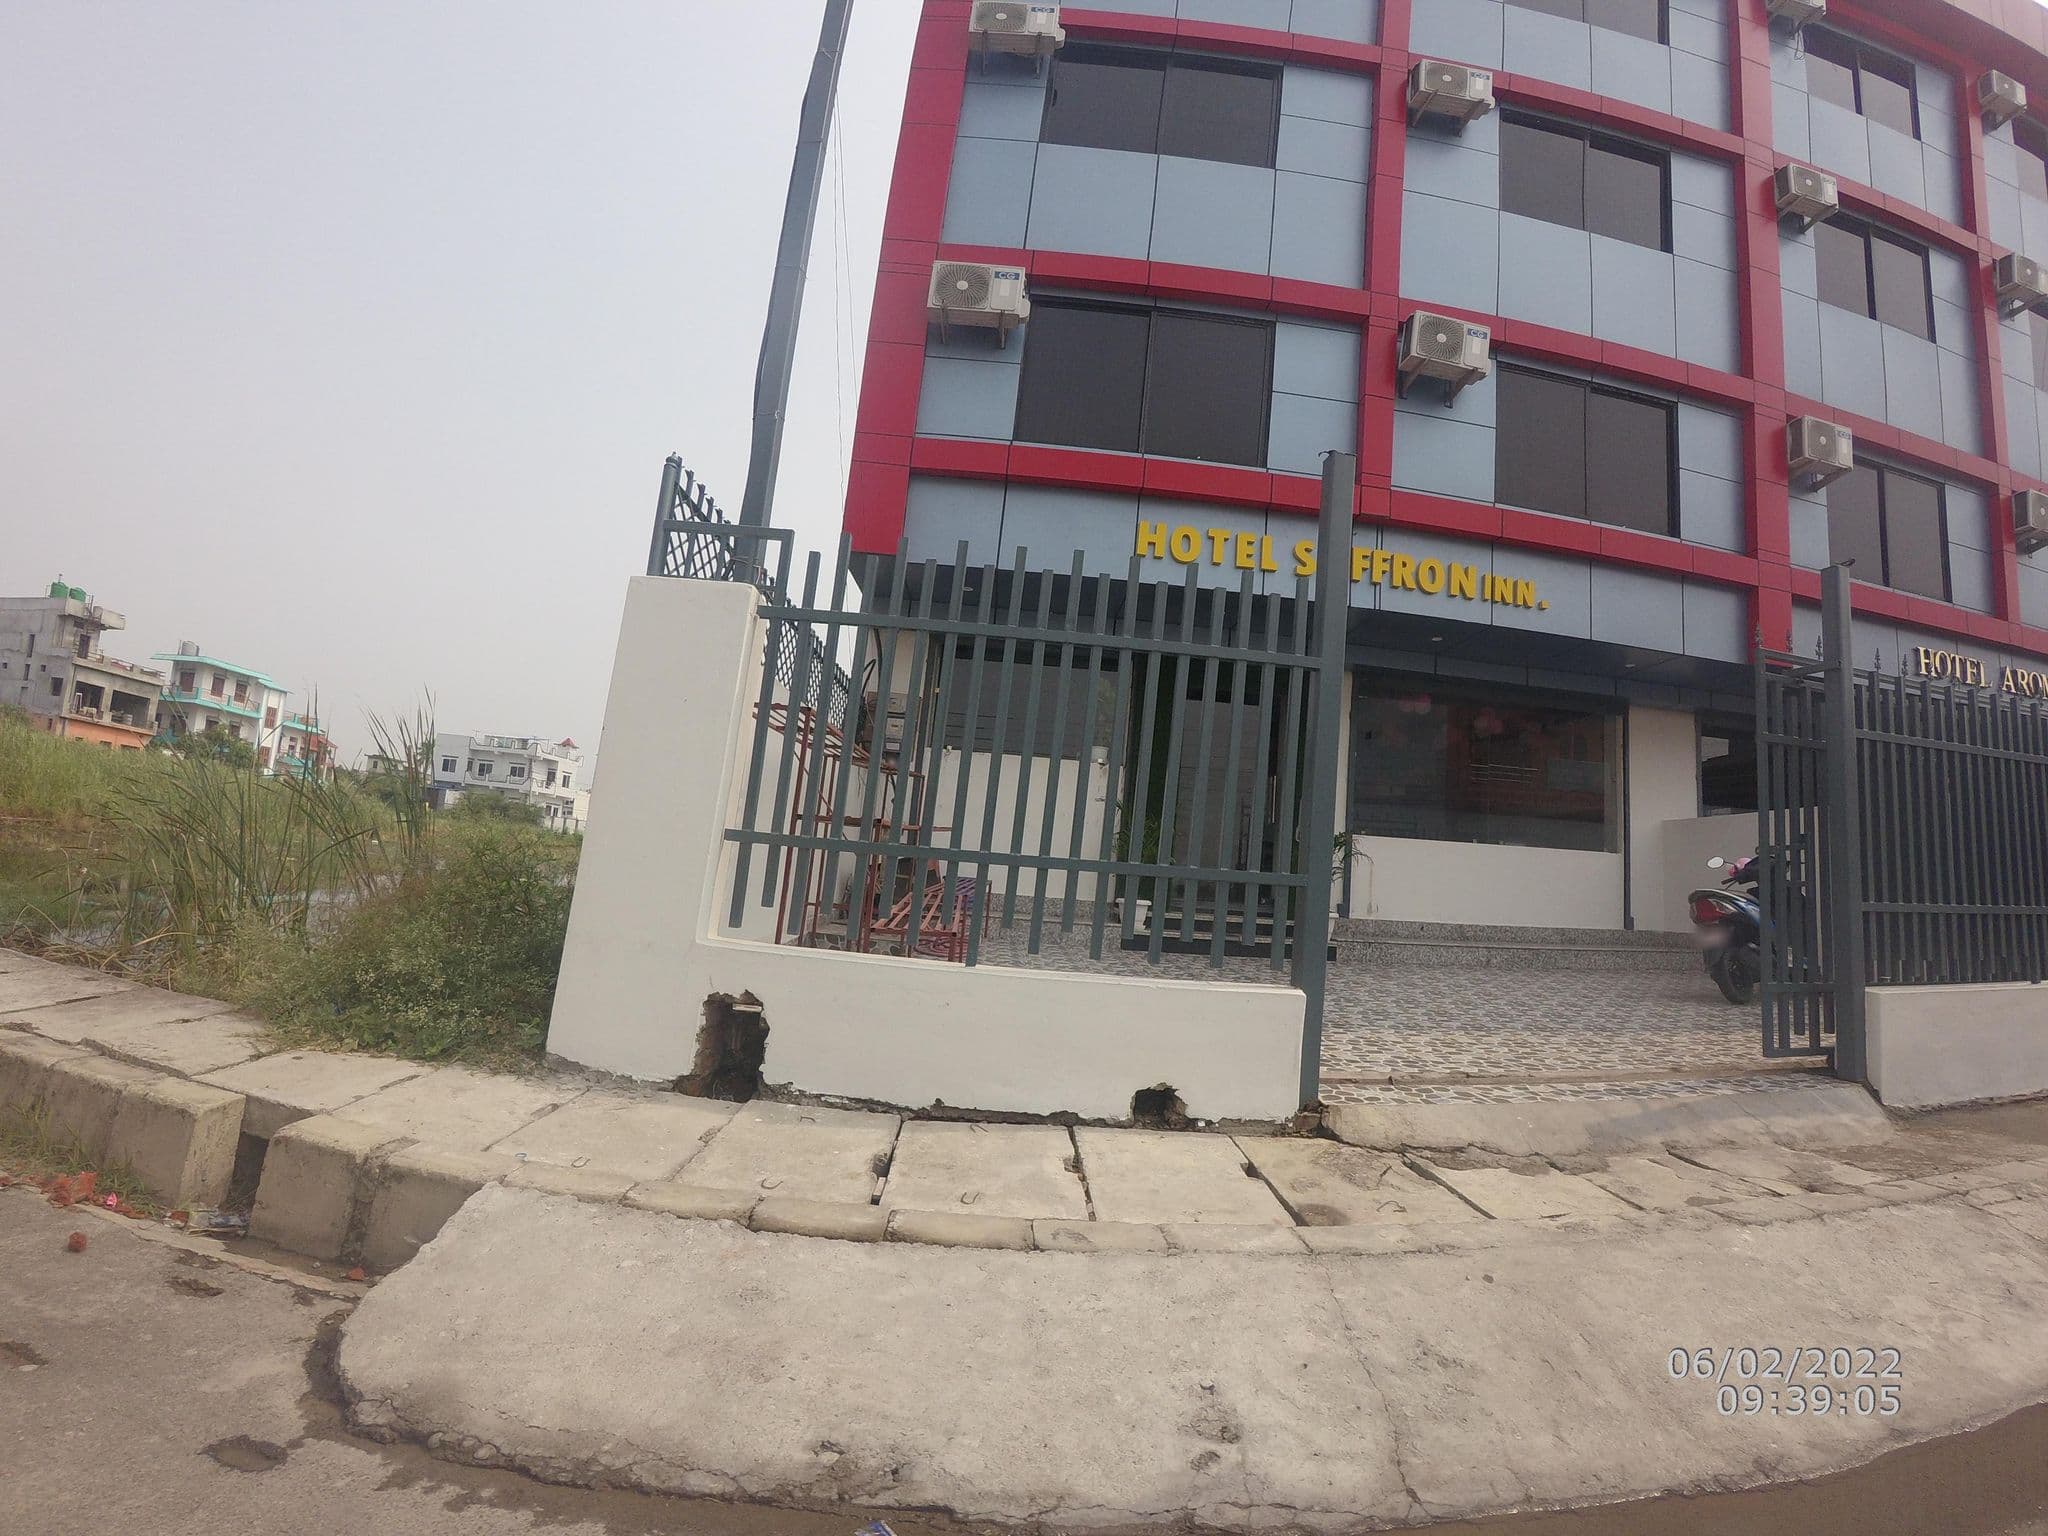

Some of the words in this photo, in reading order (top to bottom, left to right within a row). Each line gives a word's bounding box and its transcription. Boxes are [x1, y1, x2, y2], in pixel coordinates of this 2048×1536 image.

[998, 272, 1016, 280] CG
[1137, 520, 1278, 572] HOTEL
[1293, 540, 1477, 600] SFFRON
[1482, 573, 1549, 610] INN.
[1915, 646, 1993, 689] HOTEL
